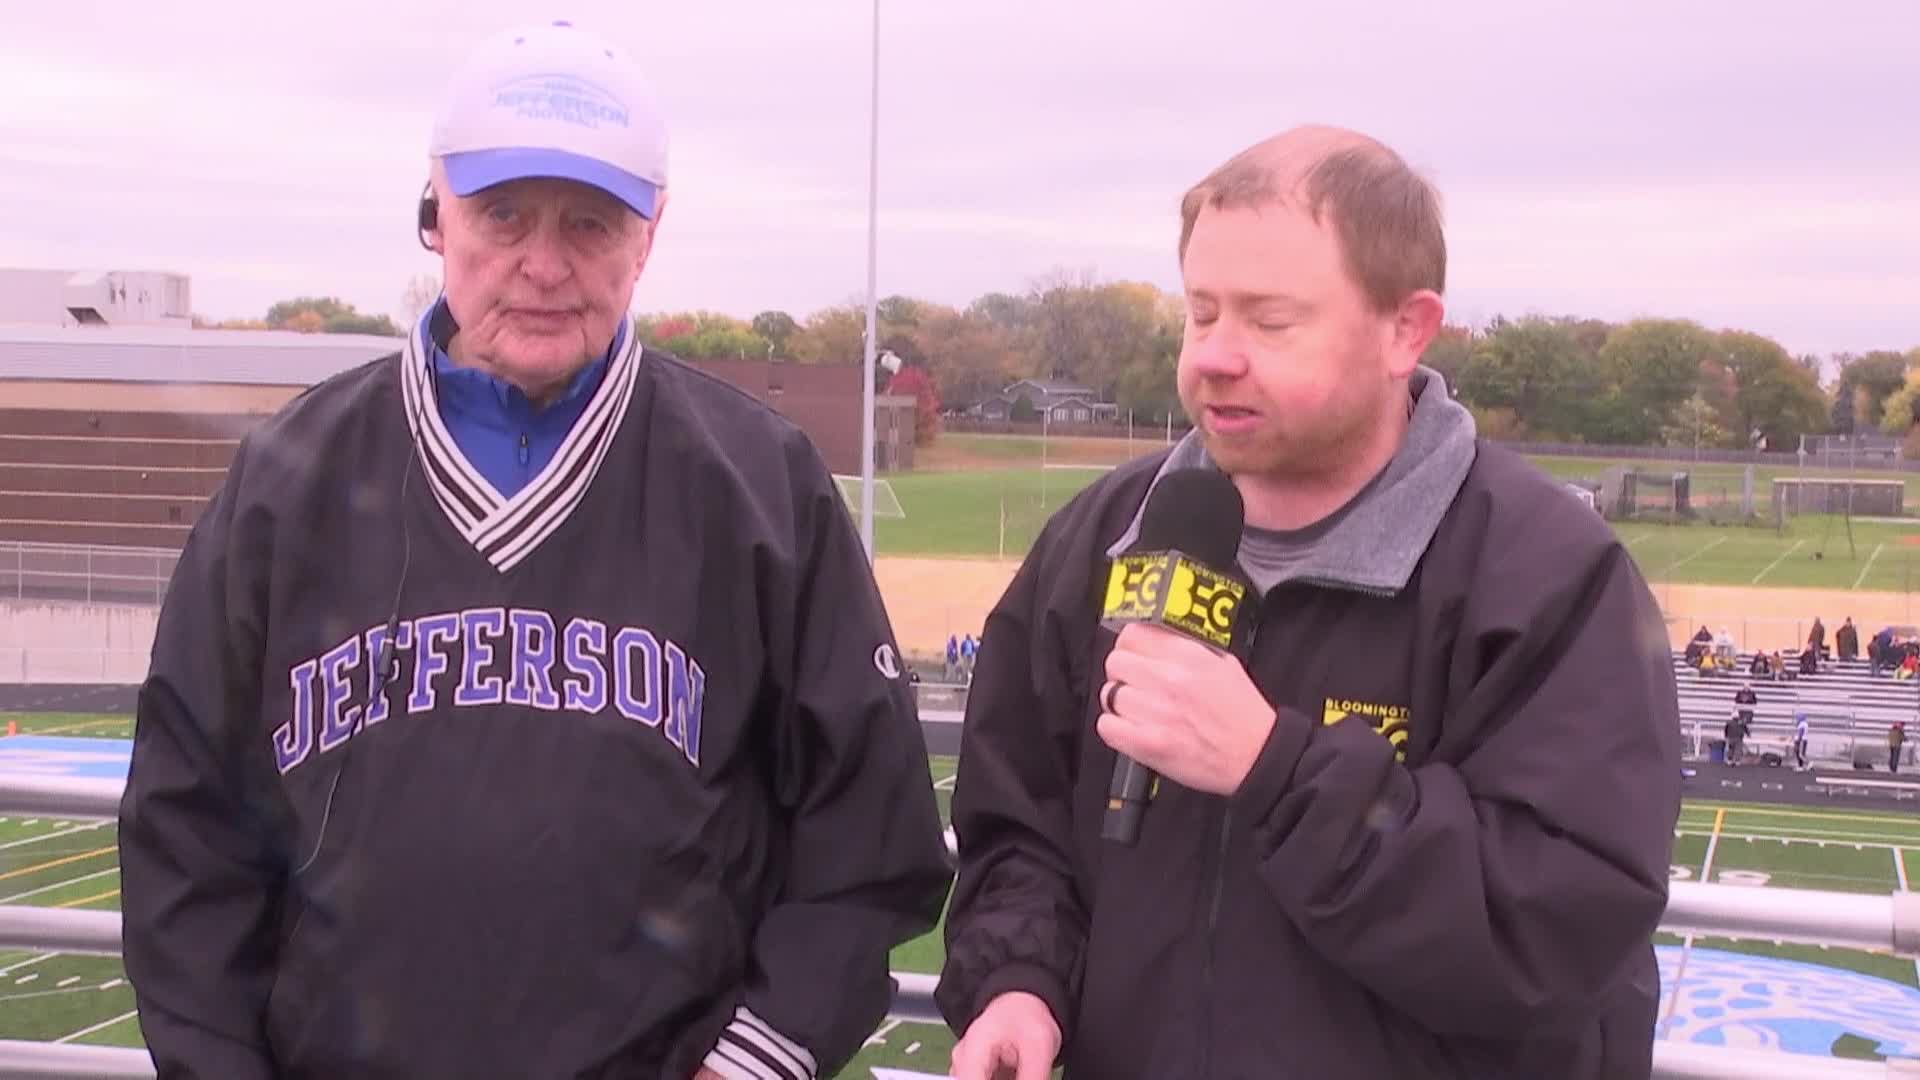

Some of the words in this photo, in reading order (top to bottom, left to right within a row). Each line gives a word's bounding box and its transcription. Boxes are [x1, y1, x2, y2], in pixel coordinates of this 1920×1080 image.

[1163, 562, 1235, 631] BEC
[271, 606, 705, 776] JEFFERSON
[1325, 697, 1409, 718] BLOOMINGT
